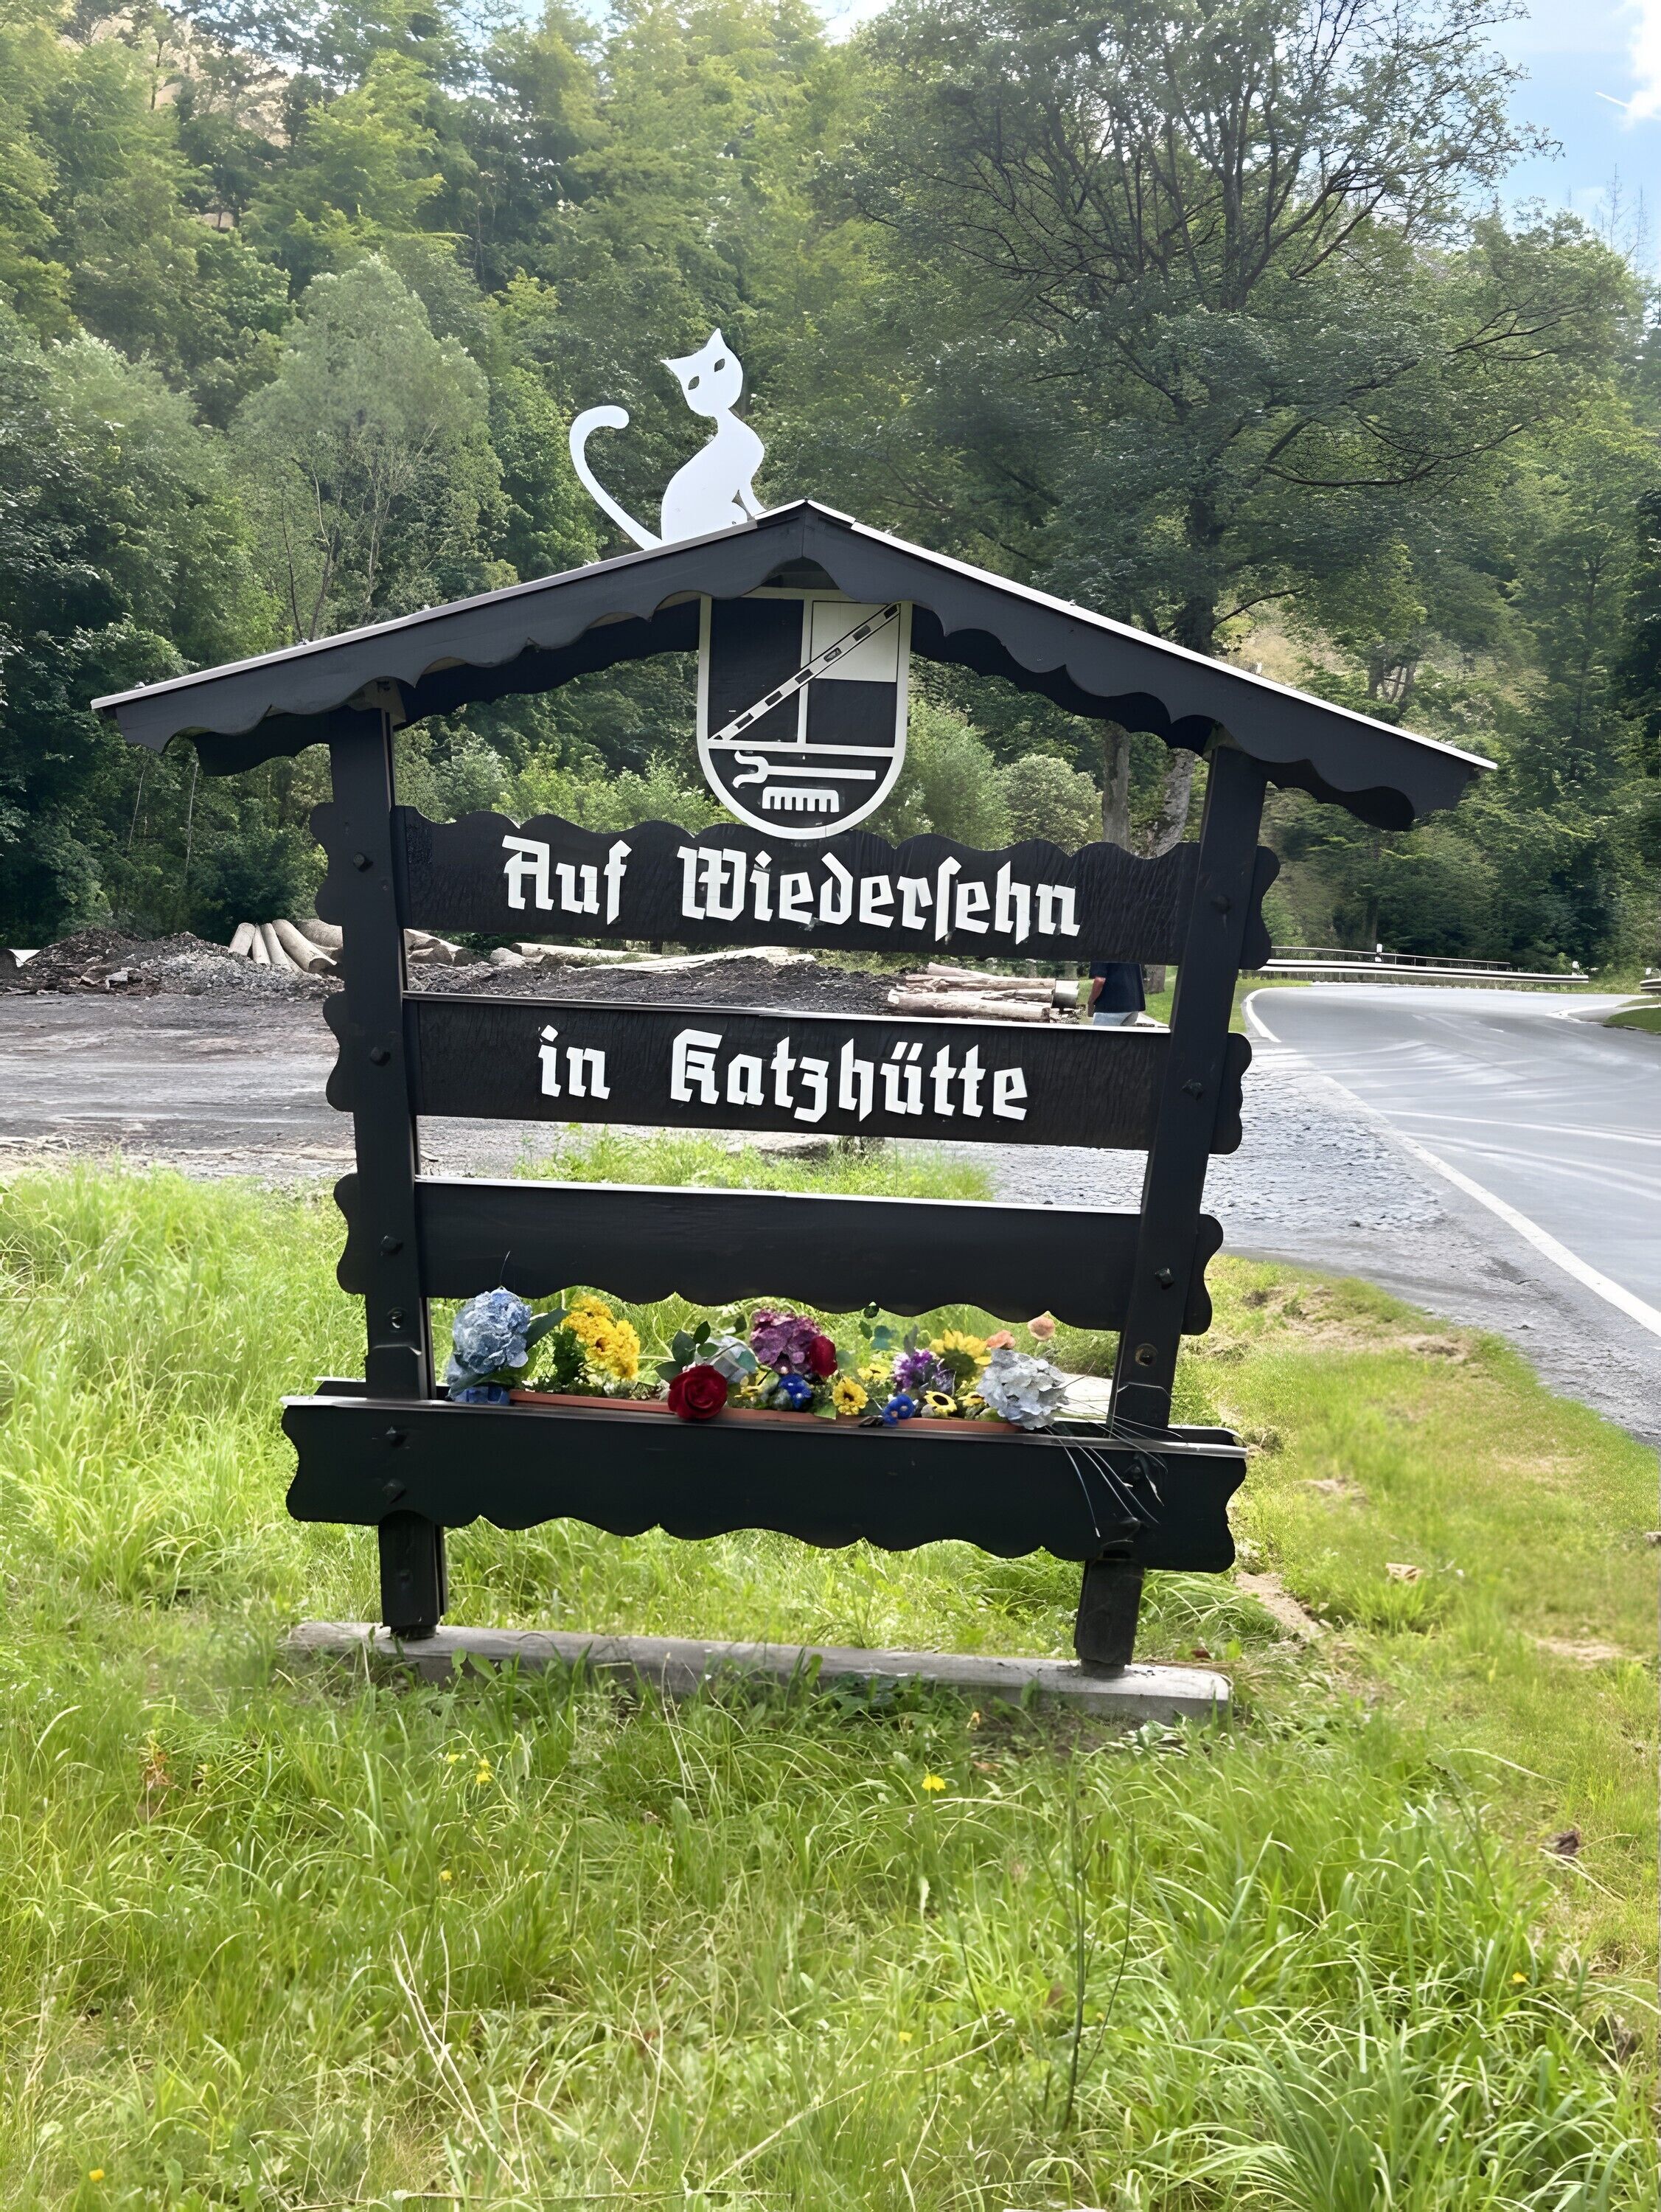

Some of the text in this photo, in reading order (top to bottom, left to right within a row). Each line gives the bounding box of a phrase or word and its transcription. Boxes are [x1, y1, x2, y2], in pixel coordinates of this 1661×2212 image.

[501, 835, 633, 925] Auf
[537, 1024, 1028, 1123] in Katzhütte
